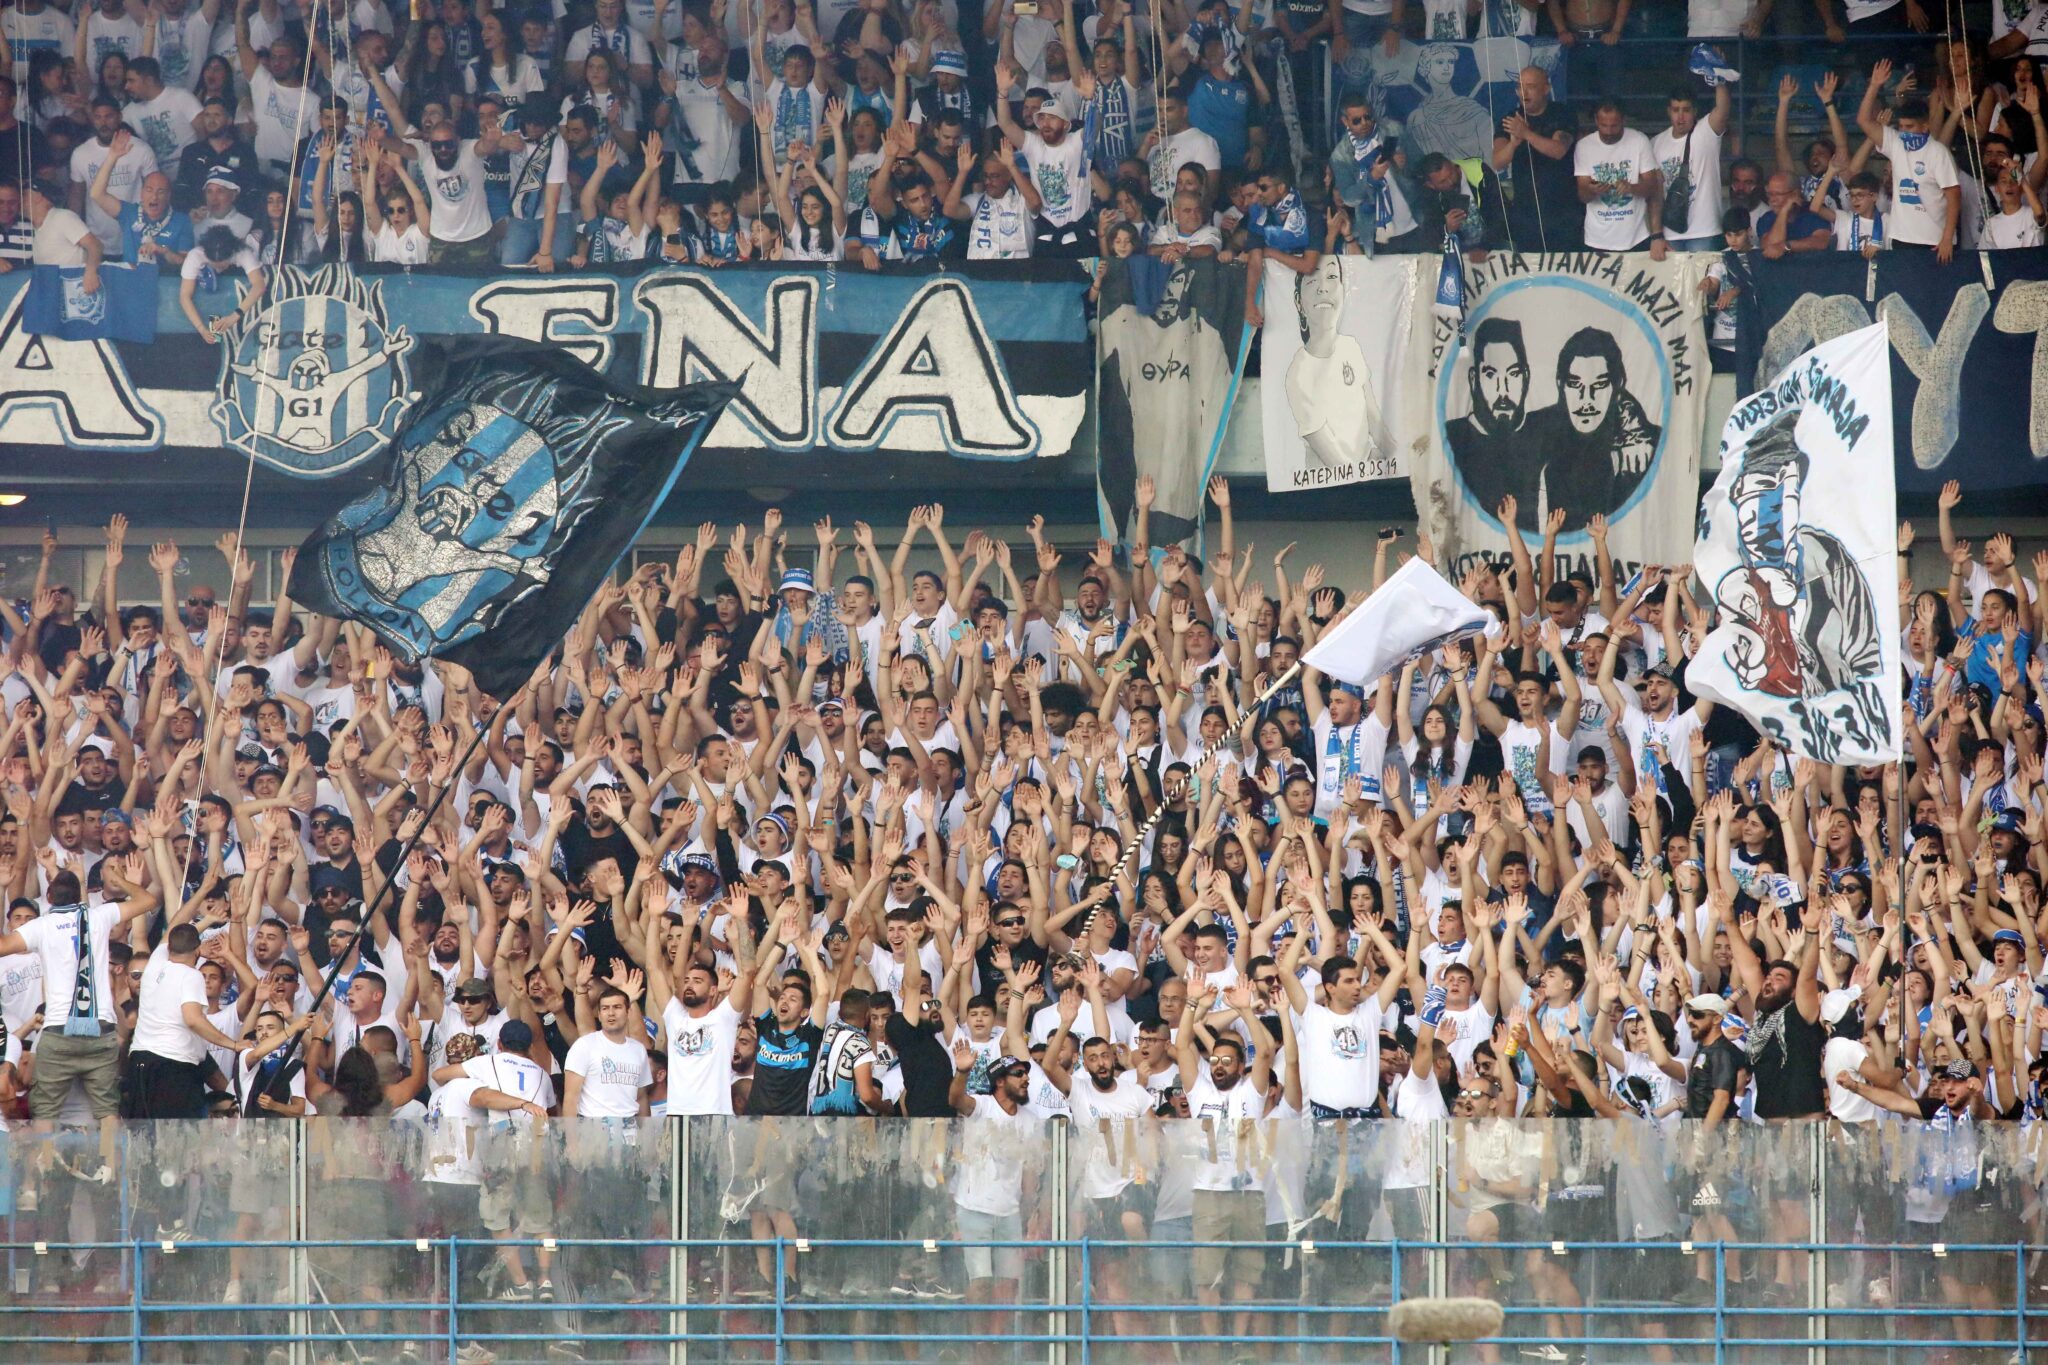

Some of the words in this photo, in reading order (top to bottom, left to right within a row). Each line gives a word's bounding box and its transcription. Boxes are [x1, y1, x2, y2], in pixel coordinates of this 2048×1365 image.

[288, 397, 324, 418] G1
[335, 546, 426, 643] POLLON
[517, 1071, 525, 1091] 1
